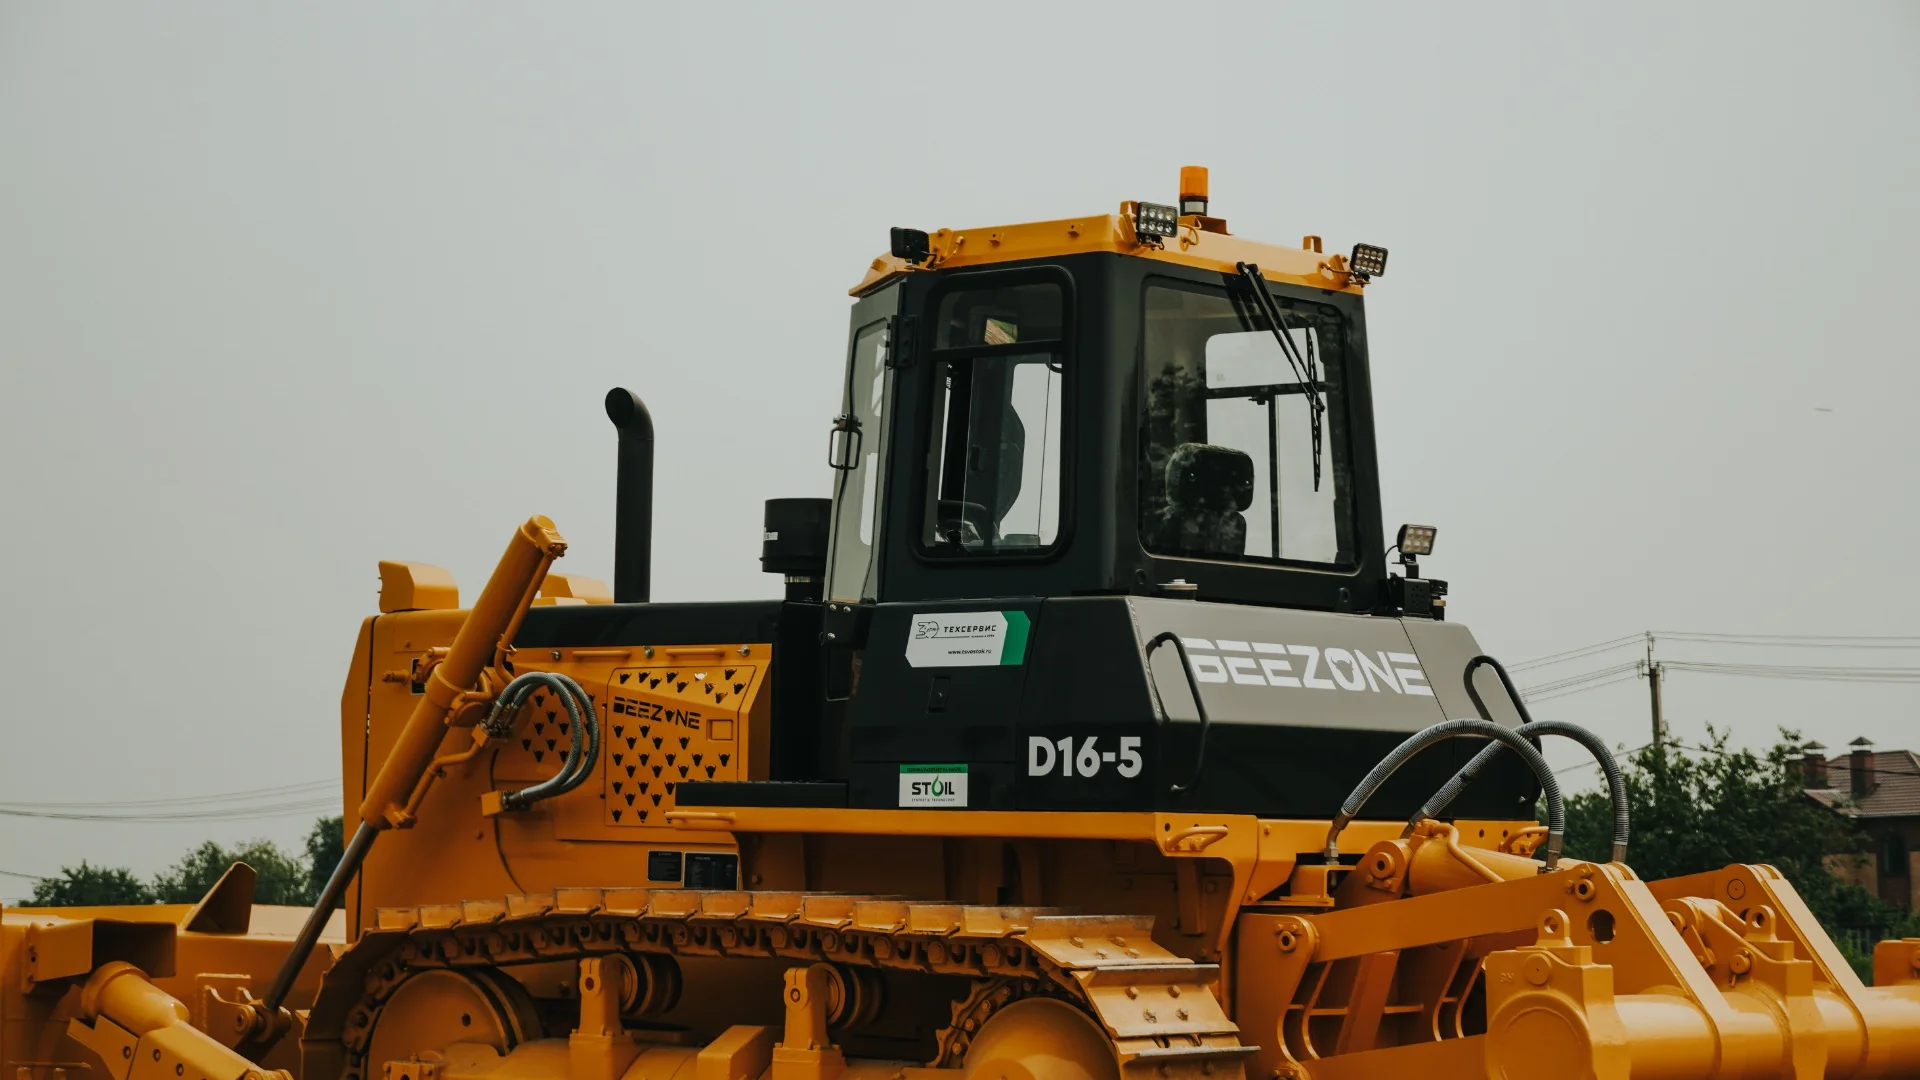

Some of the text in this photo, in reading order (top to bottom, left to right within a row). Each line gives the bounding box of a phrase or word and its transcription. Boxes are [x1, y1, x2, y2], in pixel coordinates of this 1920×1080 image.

[943, 624, 997, 634] ТЕХСЕРВИС
[1181, 637, 1435, 697] BEEZONE
[1028, 736, 1143, 778] D16-5
[912, 775, 955, 796] STOIL
